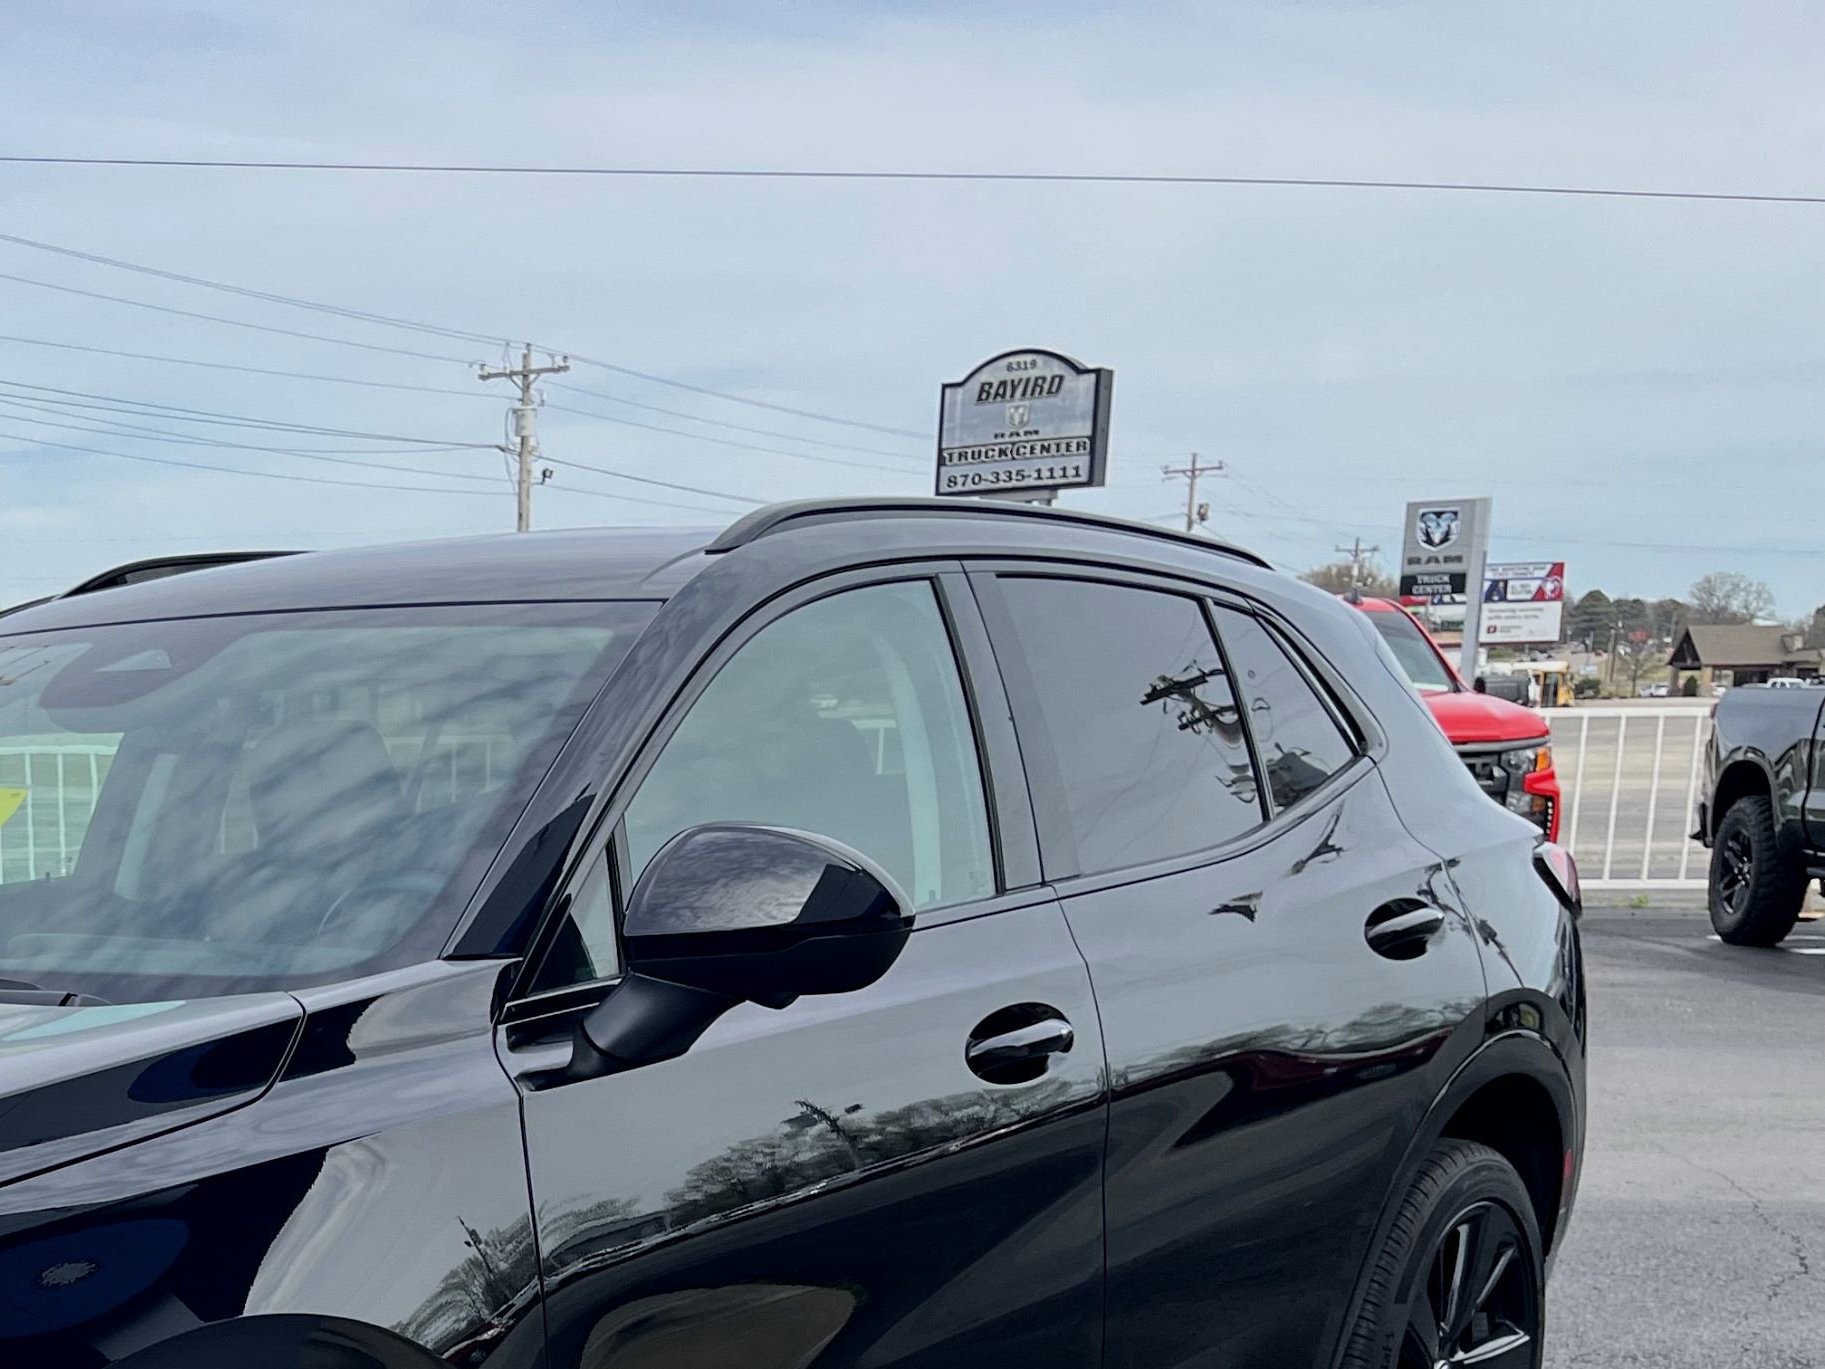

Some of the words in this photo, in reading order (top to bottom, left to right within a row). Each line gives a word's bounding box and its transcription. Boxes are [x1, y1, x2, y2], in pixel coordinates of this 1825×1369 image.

[975, 374, 1066, 402] BAYIRD
[994, 429, 1040, 440] RAM
[944, 448, 1012, 464] TRUCK
[1014, 440, 1088, 456] CENTER
[946, 465, 1082, 489] 870-335-1111
[1407, 554, 1464, 566] RAM
[1415, 573, 1451, 584] TRUCK
[1411, 584, 1453, 595] CENTER
